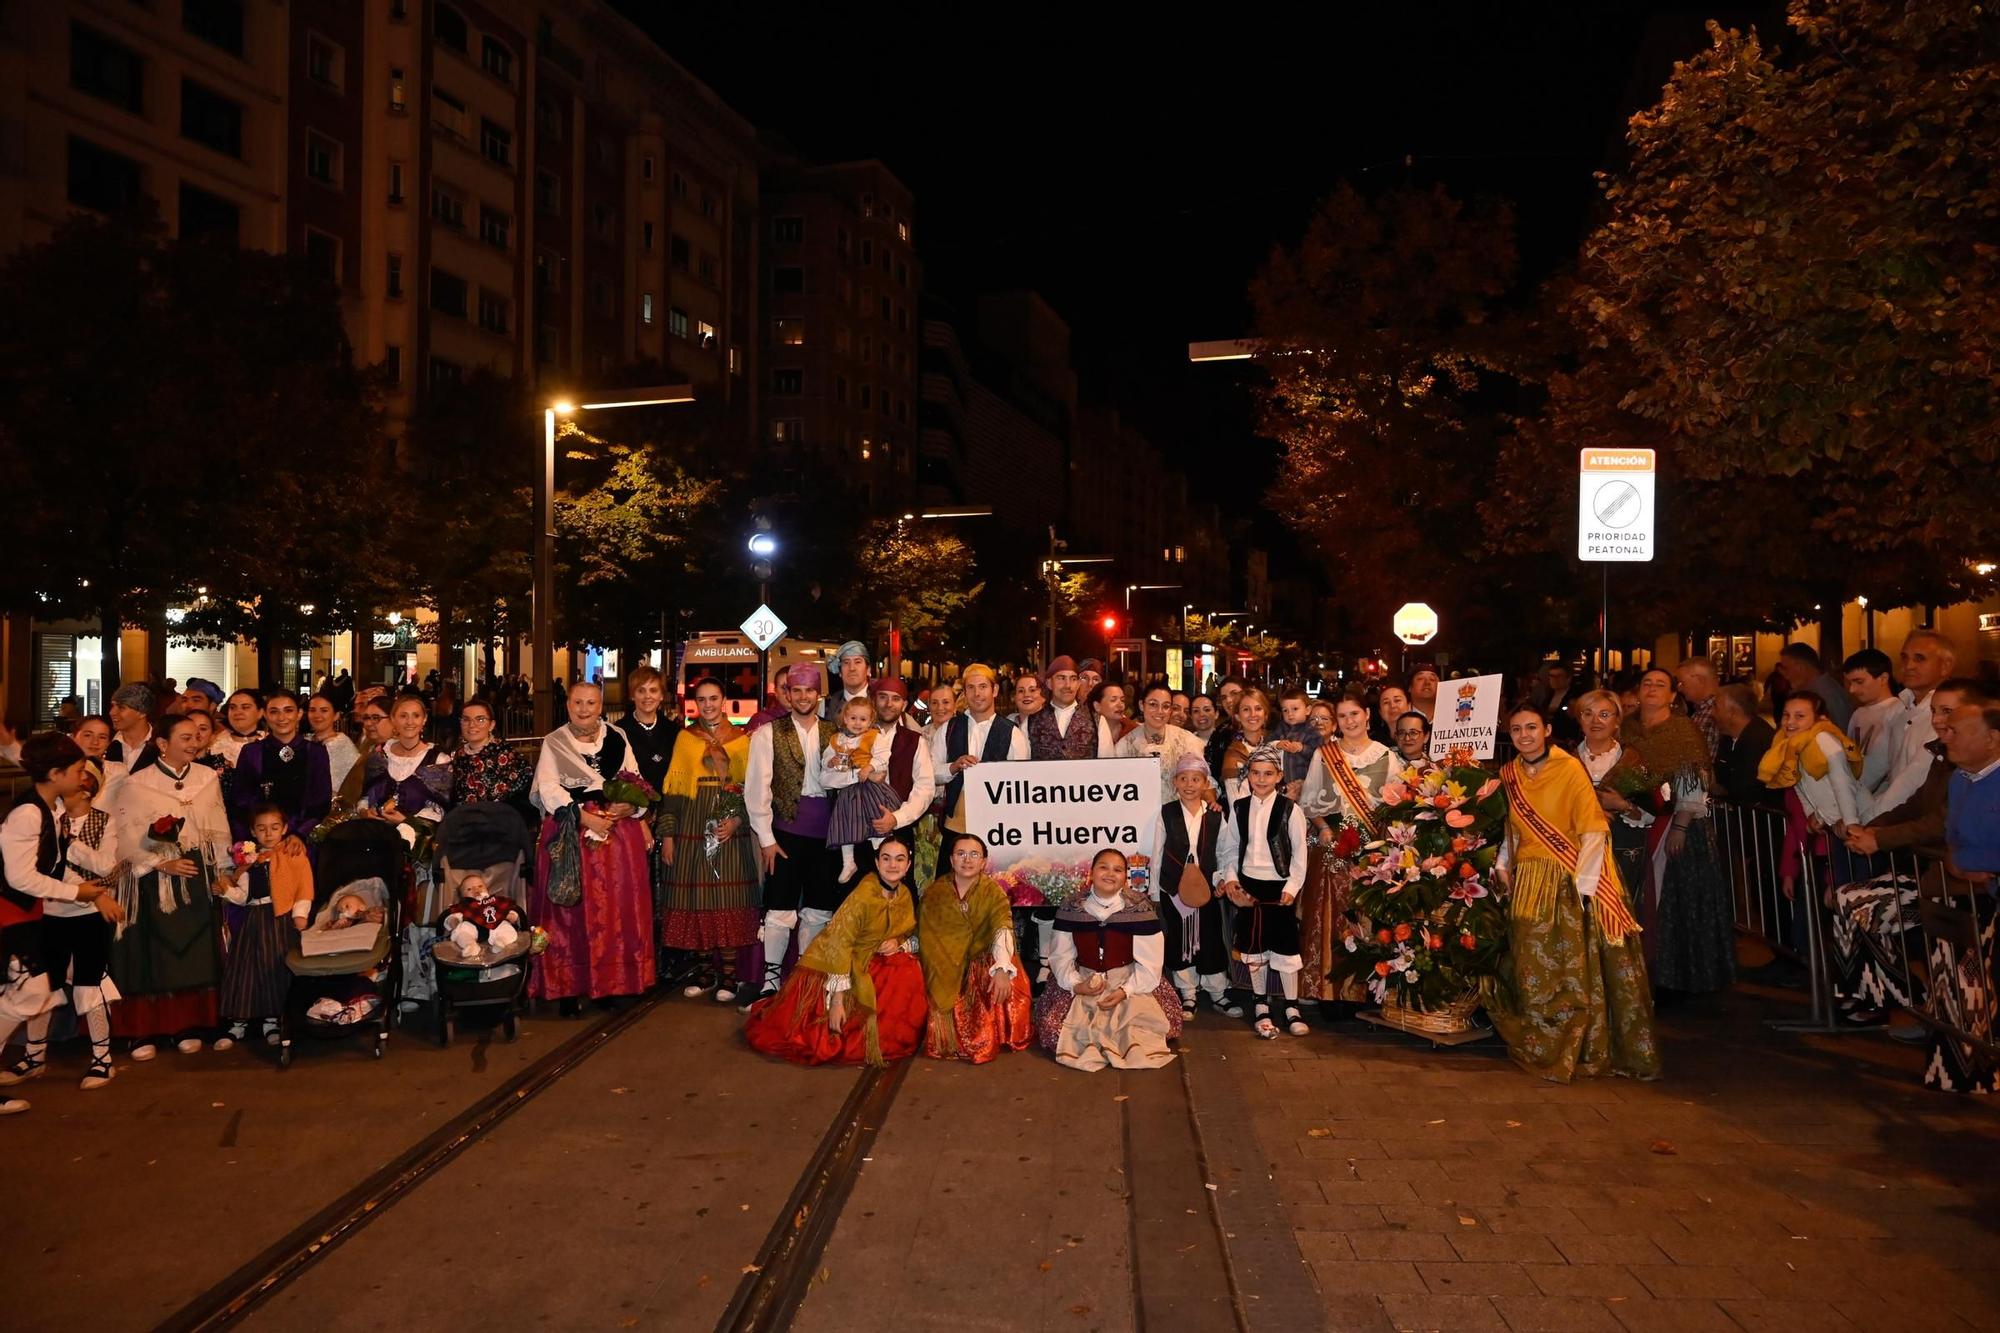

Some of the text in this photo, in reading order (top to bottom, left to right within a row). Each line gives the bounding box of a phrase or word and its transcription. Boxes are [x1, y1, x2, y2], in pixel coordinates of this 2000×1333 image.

[1589, 455, 1647, 466] ATENCIÓN
[1587, 532, 1646, 541] PRIORIDAD
[1588, 546, 1645, 554] PEATONAL
[753, 620, 774, 635] 30
[1433, 726, 1493, 740] VILLANUEVA
[1433, 743, 1447, 754] DE
[983, 780, 1140, 805] Villanueva
[987, 821, 1138, 846] de Huerva
